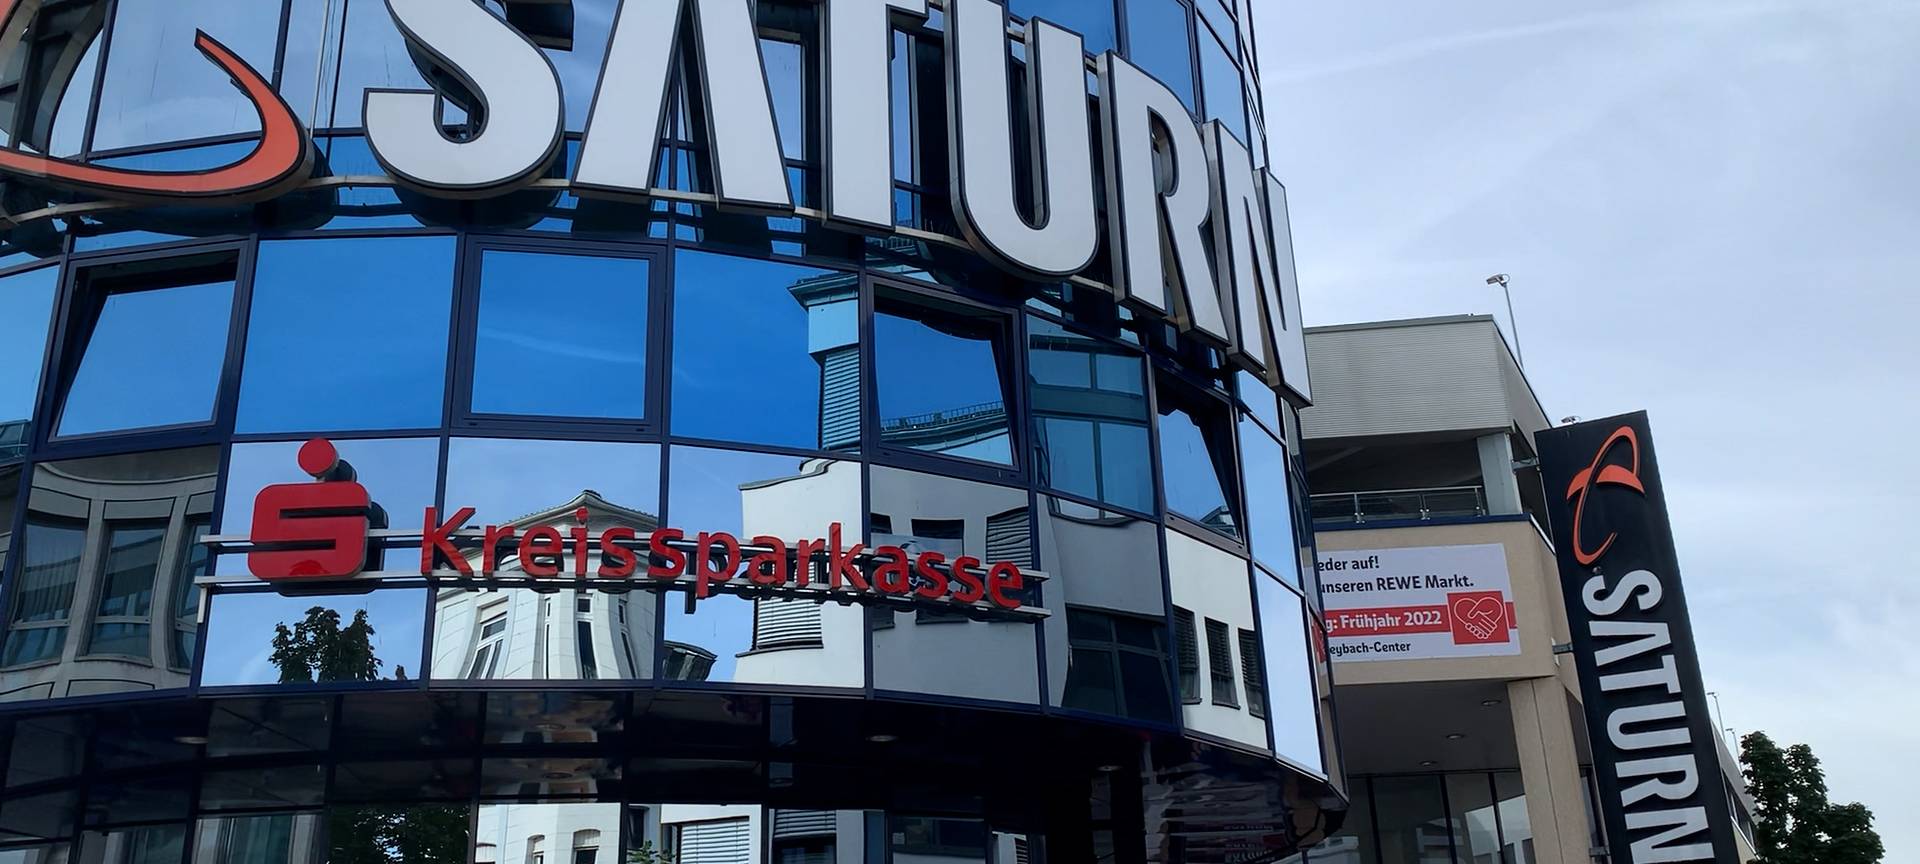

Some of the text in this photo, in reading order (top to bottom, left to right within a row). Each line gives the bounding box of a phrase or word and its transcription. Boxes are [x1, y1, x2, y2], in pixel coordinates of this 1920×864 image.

[361, 0, 1313, 407] SATURN
[421, 507, 1023, 609] Kreissparkasse
[1351, 555, 1380, 570] auf!
[1376, 576, 1422, 591] REWE
[1425, 574, 1474, 589] Markt.
[1340, 613, 1401, 631] Frühjahr
[1403, 610, 1442, 626] 2022
[1582, 569, 1716, 864] SATURN
